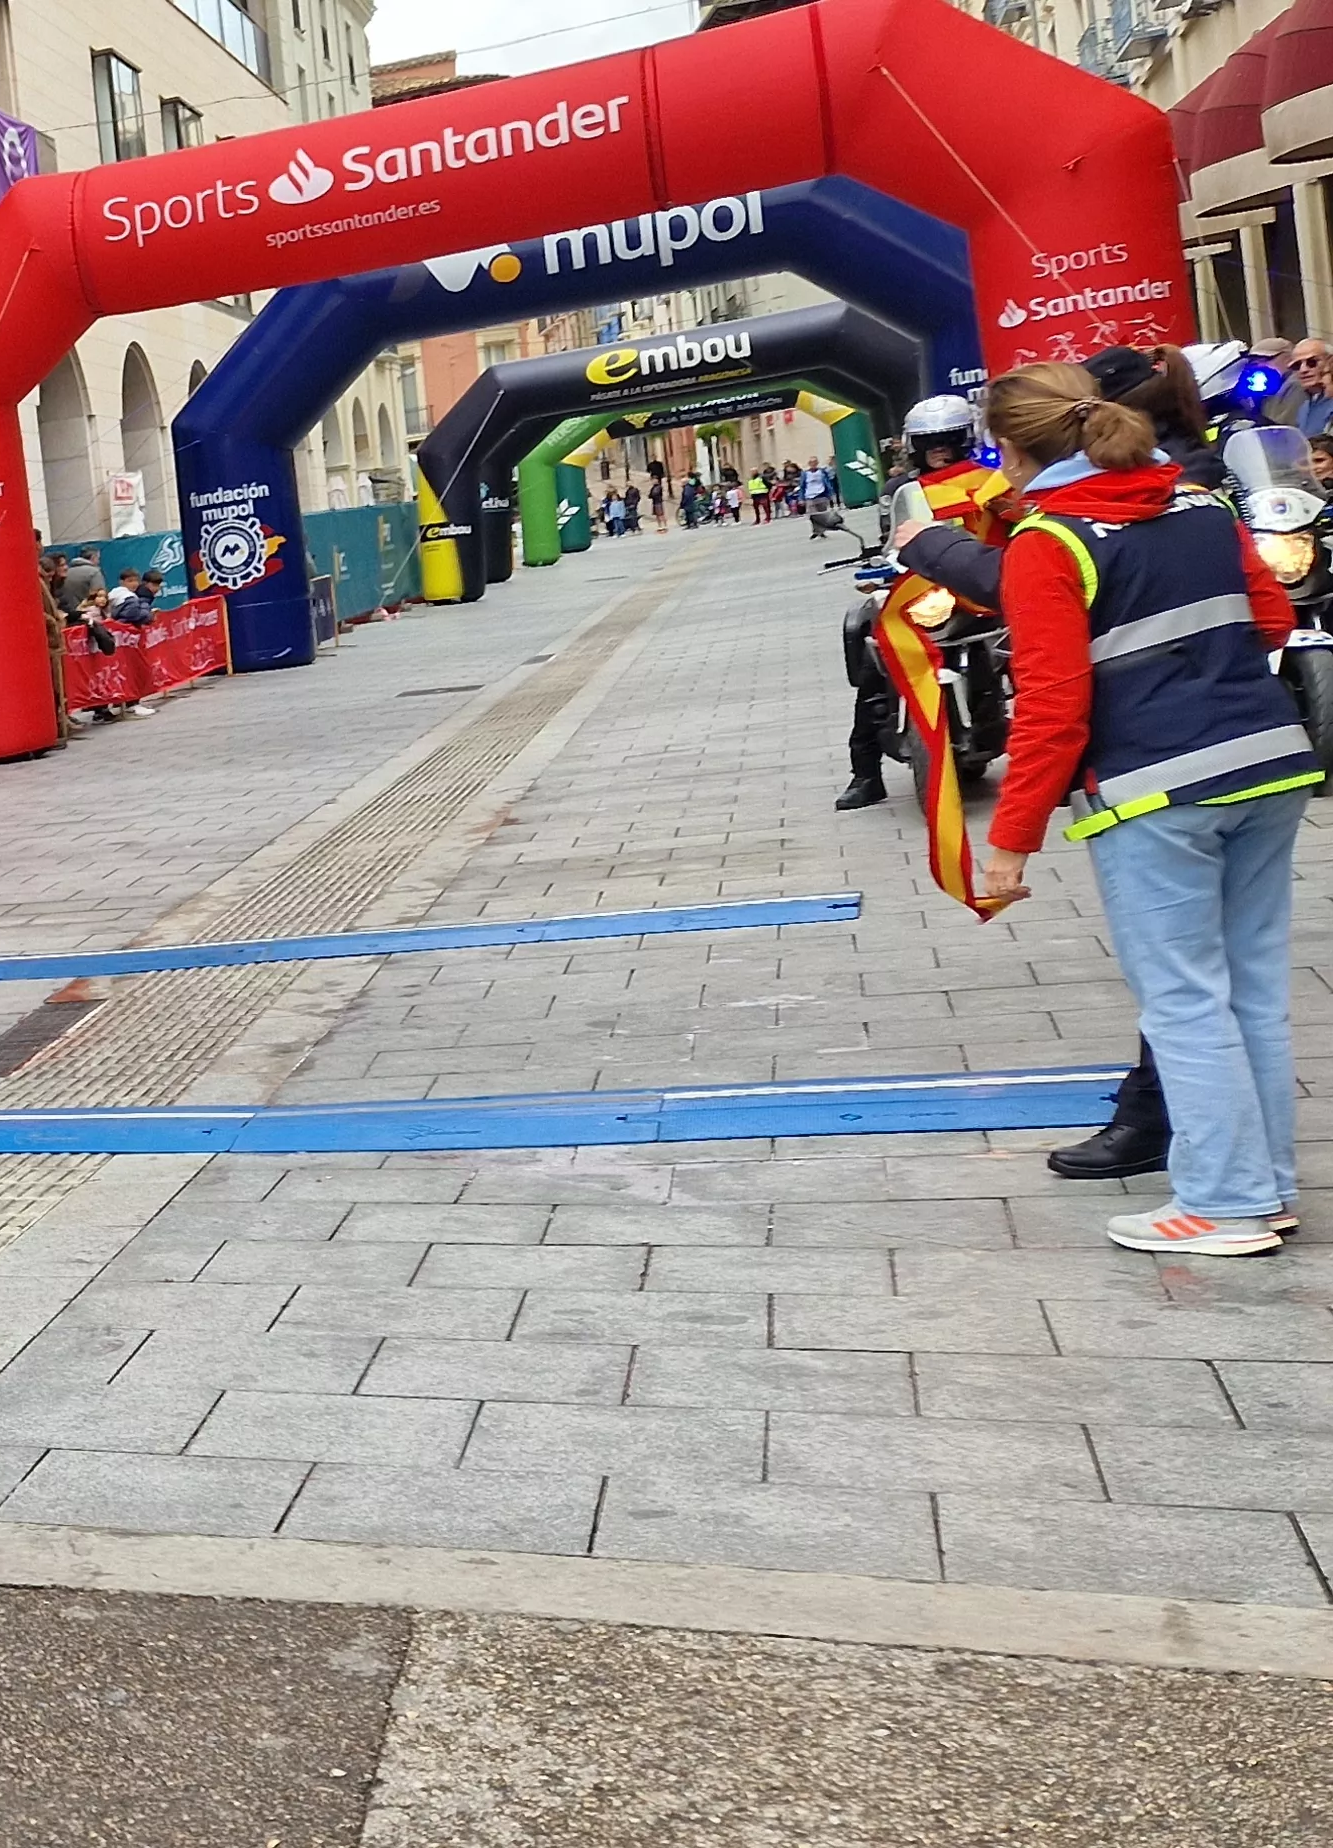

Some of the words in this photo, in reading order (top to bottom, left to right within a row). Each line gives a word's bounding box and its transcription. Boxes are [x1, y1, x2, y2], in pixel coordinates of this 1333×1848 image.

[102, 178, 260, 247] Sports
[343, 95, 629, 192] Santander
[265, 198, 441, 250] sportssantander.es
[543, 191, 764, 275] mupol
[1031, 243, 1128, 280] Sports
[1029, 278, 1173, 321] Santander
[586, 331, 752, 386] embou
[189, 482, 270, 508] fundación
[202, 500, 254, 522] mupol
